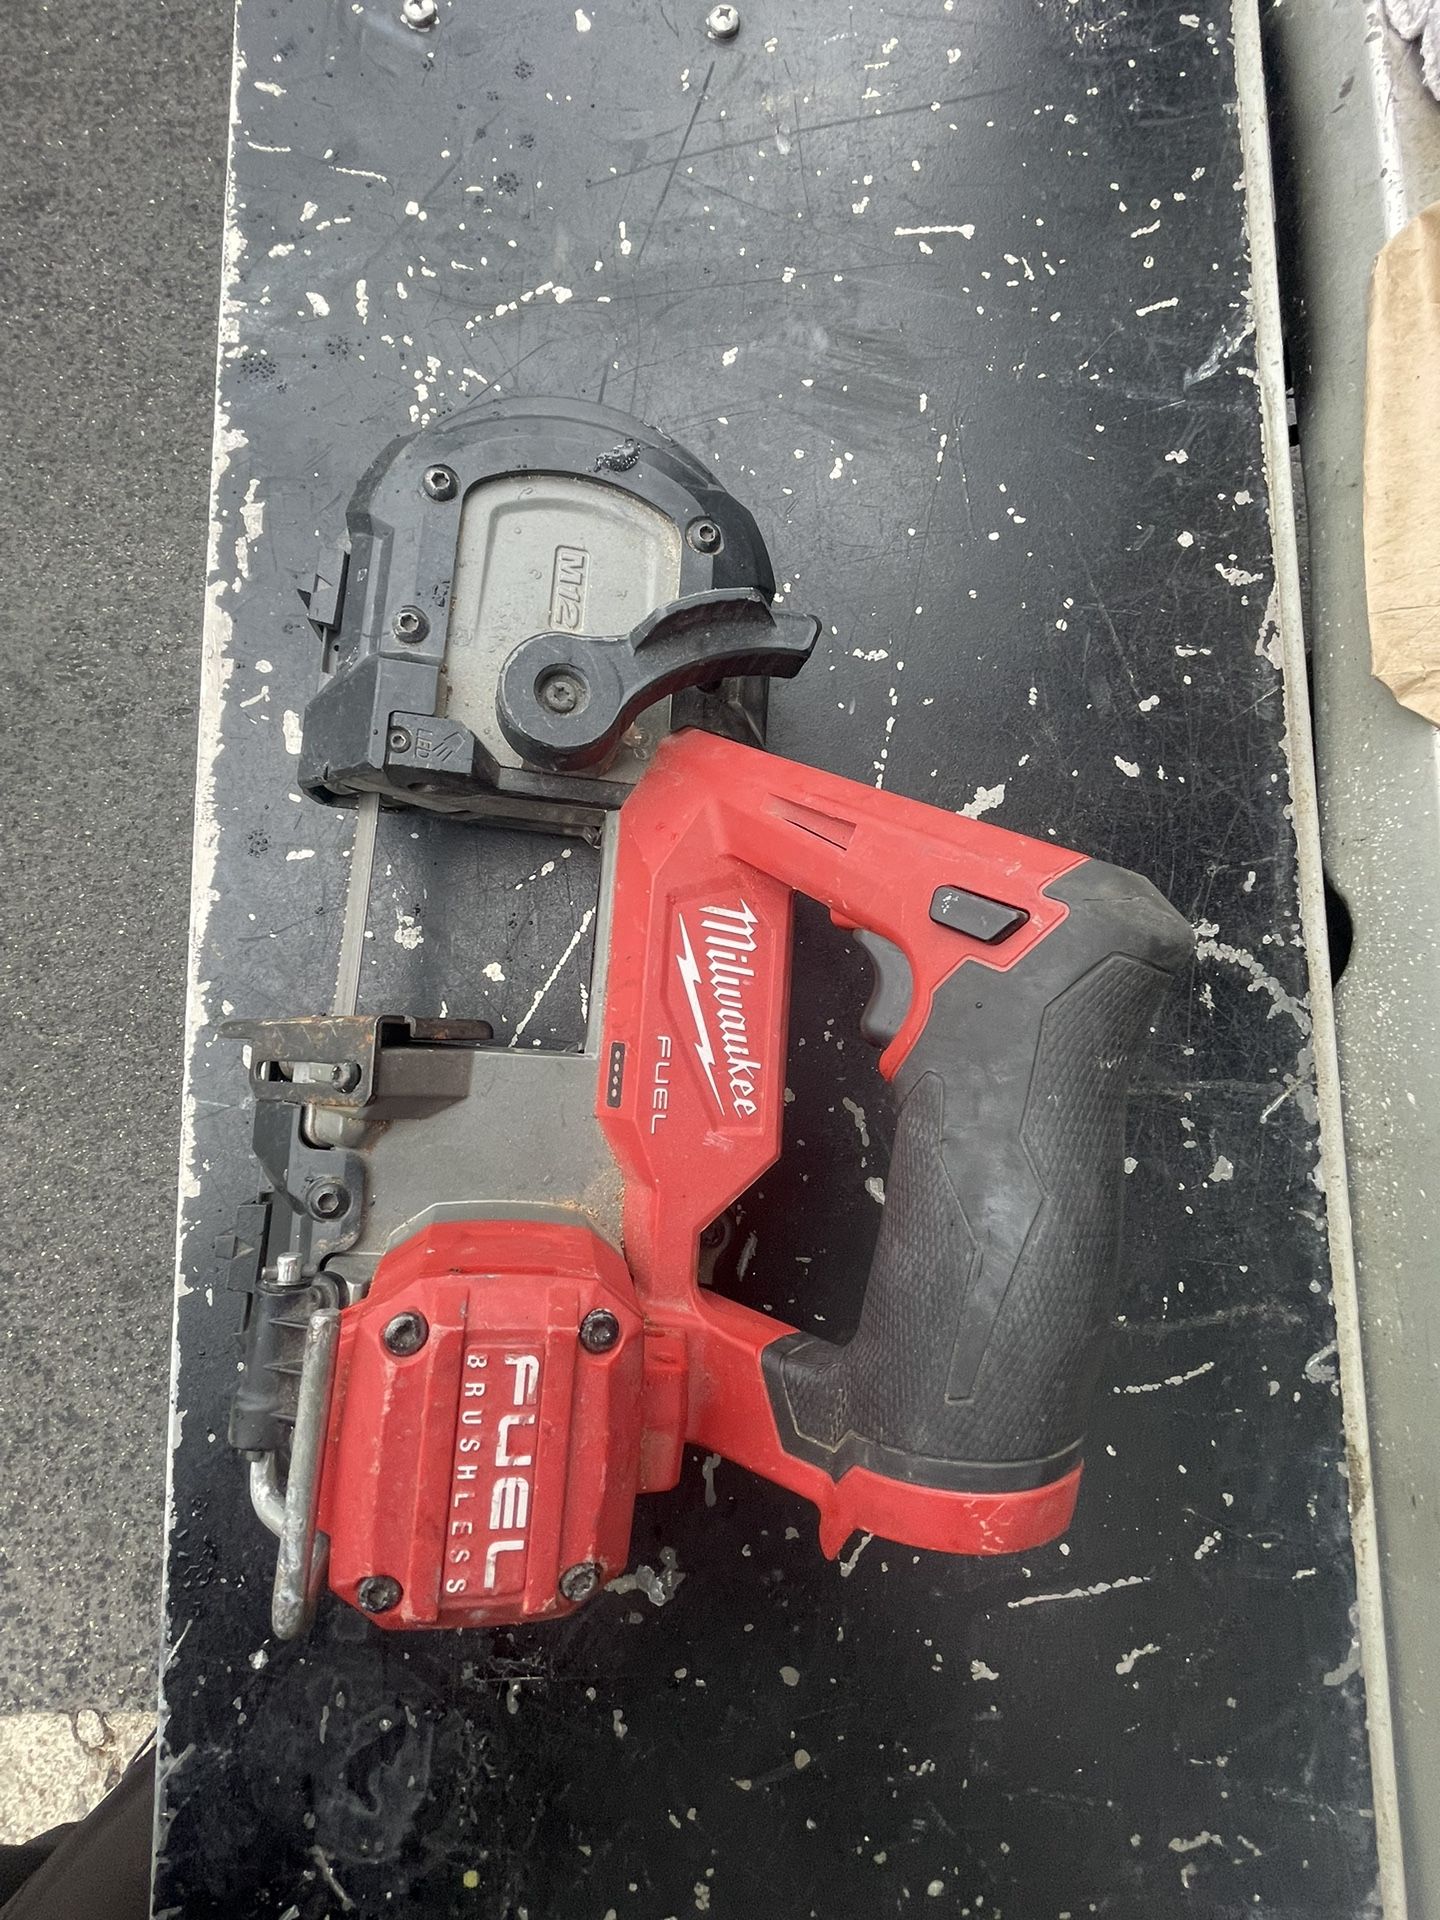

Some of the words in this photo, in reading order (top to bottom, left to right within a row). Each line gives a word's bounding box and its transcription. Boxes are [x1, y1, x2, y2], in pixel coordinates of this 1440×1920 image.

[555, 552, 584, 630] M12
[414, 728, 433, 759] LED
[651, 1035, 672, 1135] FUEL
[699, 898, 761, 1120] Milwaukee
[446, 1353, 488, 1593] BRUSHLESS
[484, 1354, 540, 1590] FUEL
